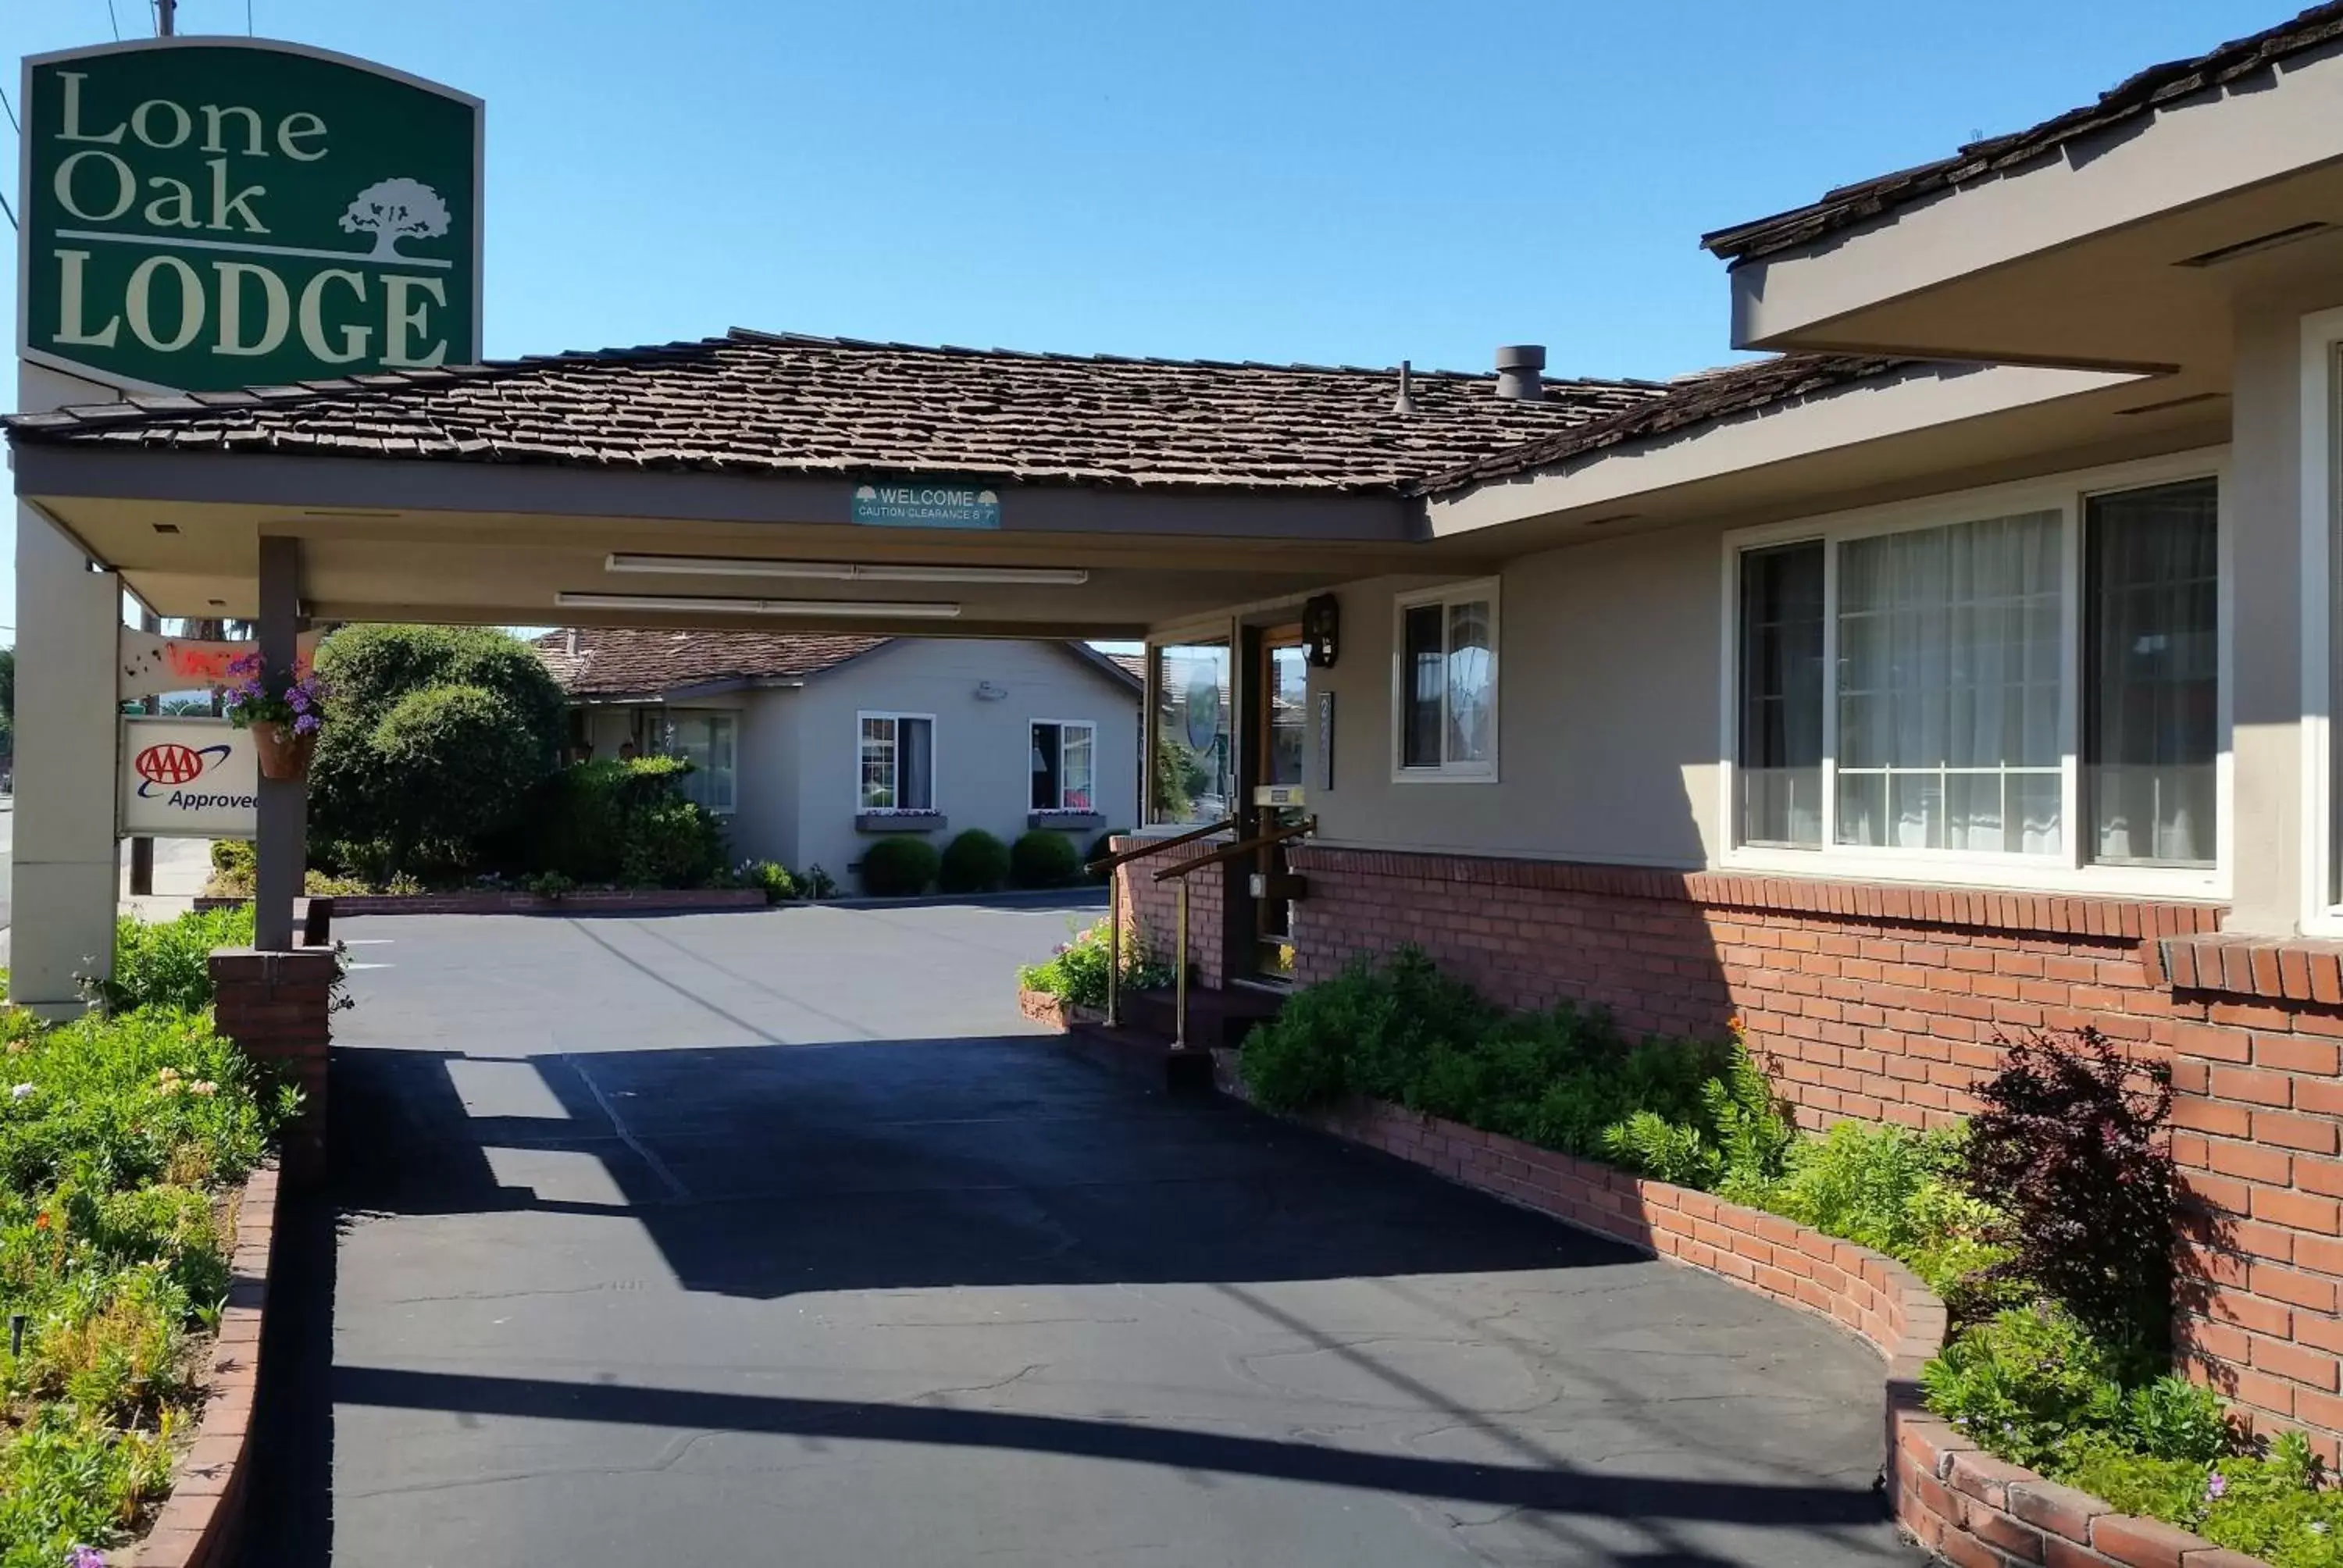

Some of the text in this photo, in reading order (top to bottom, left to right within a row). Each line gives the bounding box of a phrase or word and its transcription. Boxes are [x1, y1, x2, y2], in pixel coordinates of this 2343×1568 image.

[55, 71, 330, 162] Lone
[54, 151, 271, 233] Oak
[52, 248, 448, 369] LODGE
[858, 506, 905, 517] CAUTION
[908, 508, 969, 519] CLEARANCE
[879, 488, 974, 507] WELCOME
[143, 746, 197, 783] AAA
